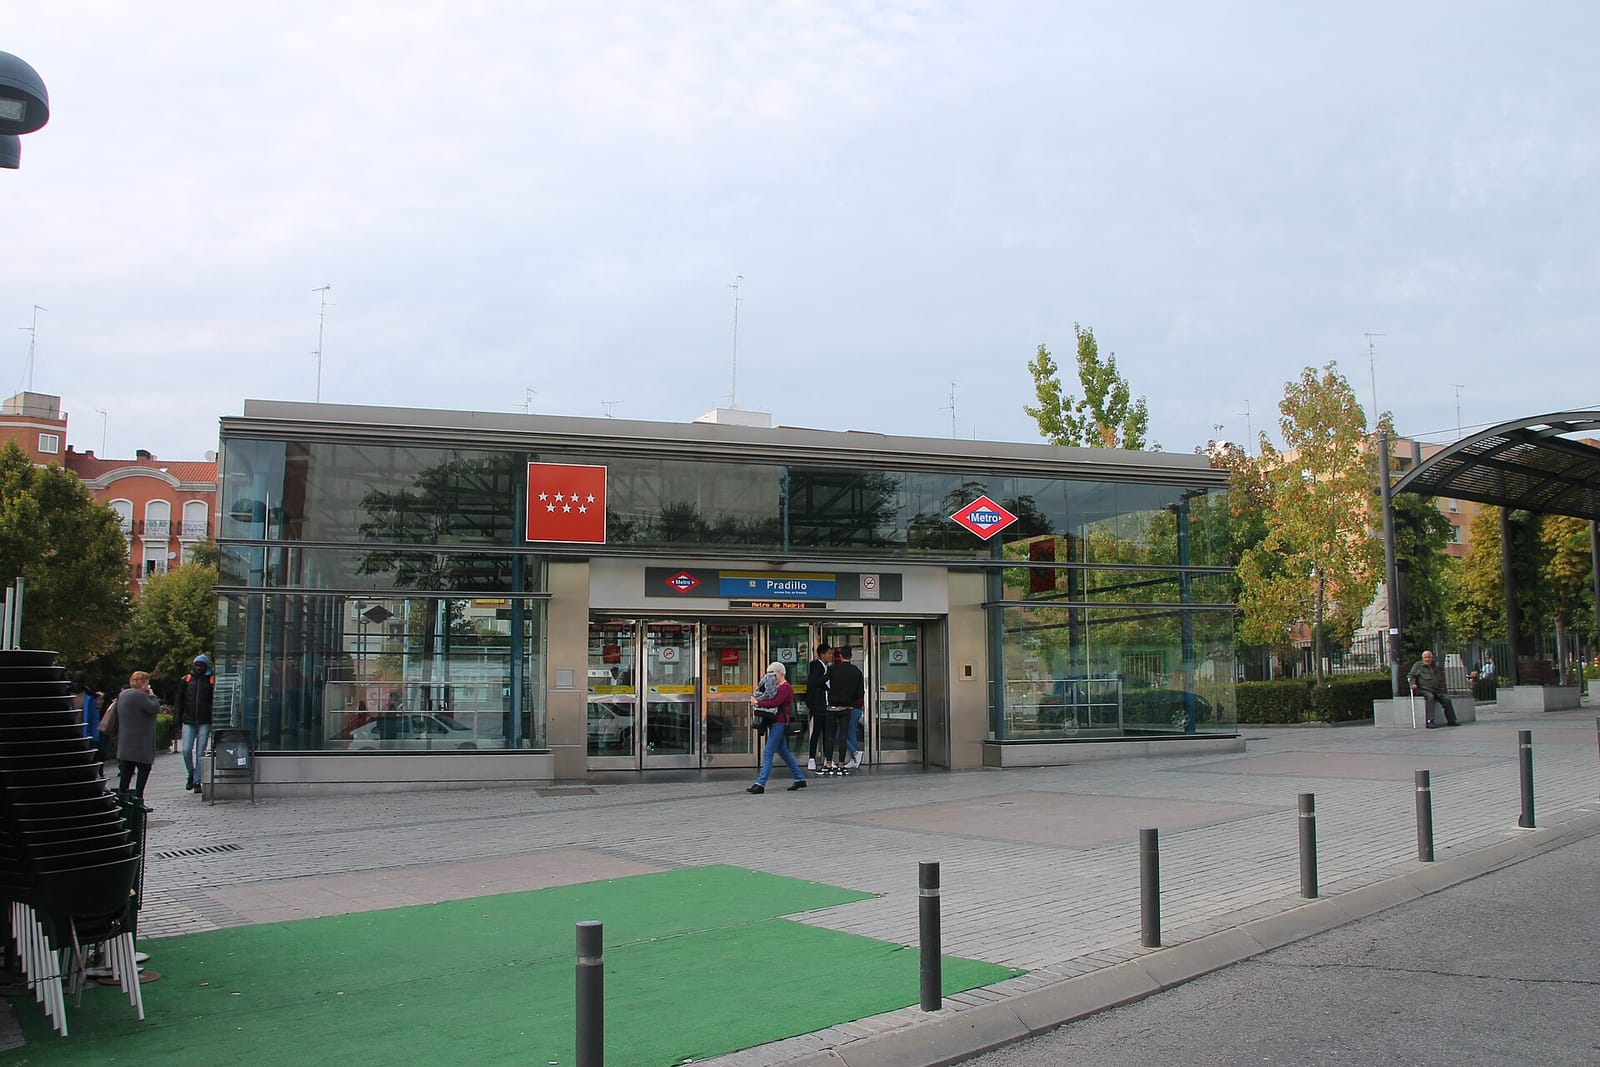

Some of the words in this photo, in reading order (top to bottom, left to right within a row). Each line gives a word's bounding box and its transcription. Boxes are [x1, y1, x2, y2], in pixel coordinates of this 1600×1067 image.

[971, 512, 998, 523] Metro
[675, 578, 691, 586] Metro
[767, 580, 807, 590] Pradillo
